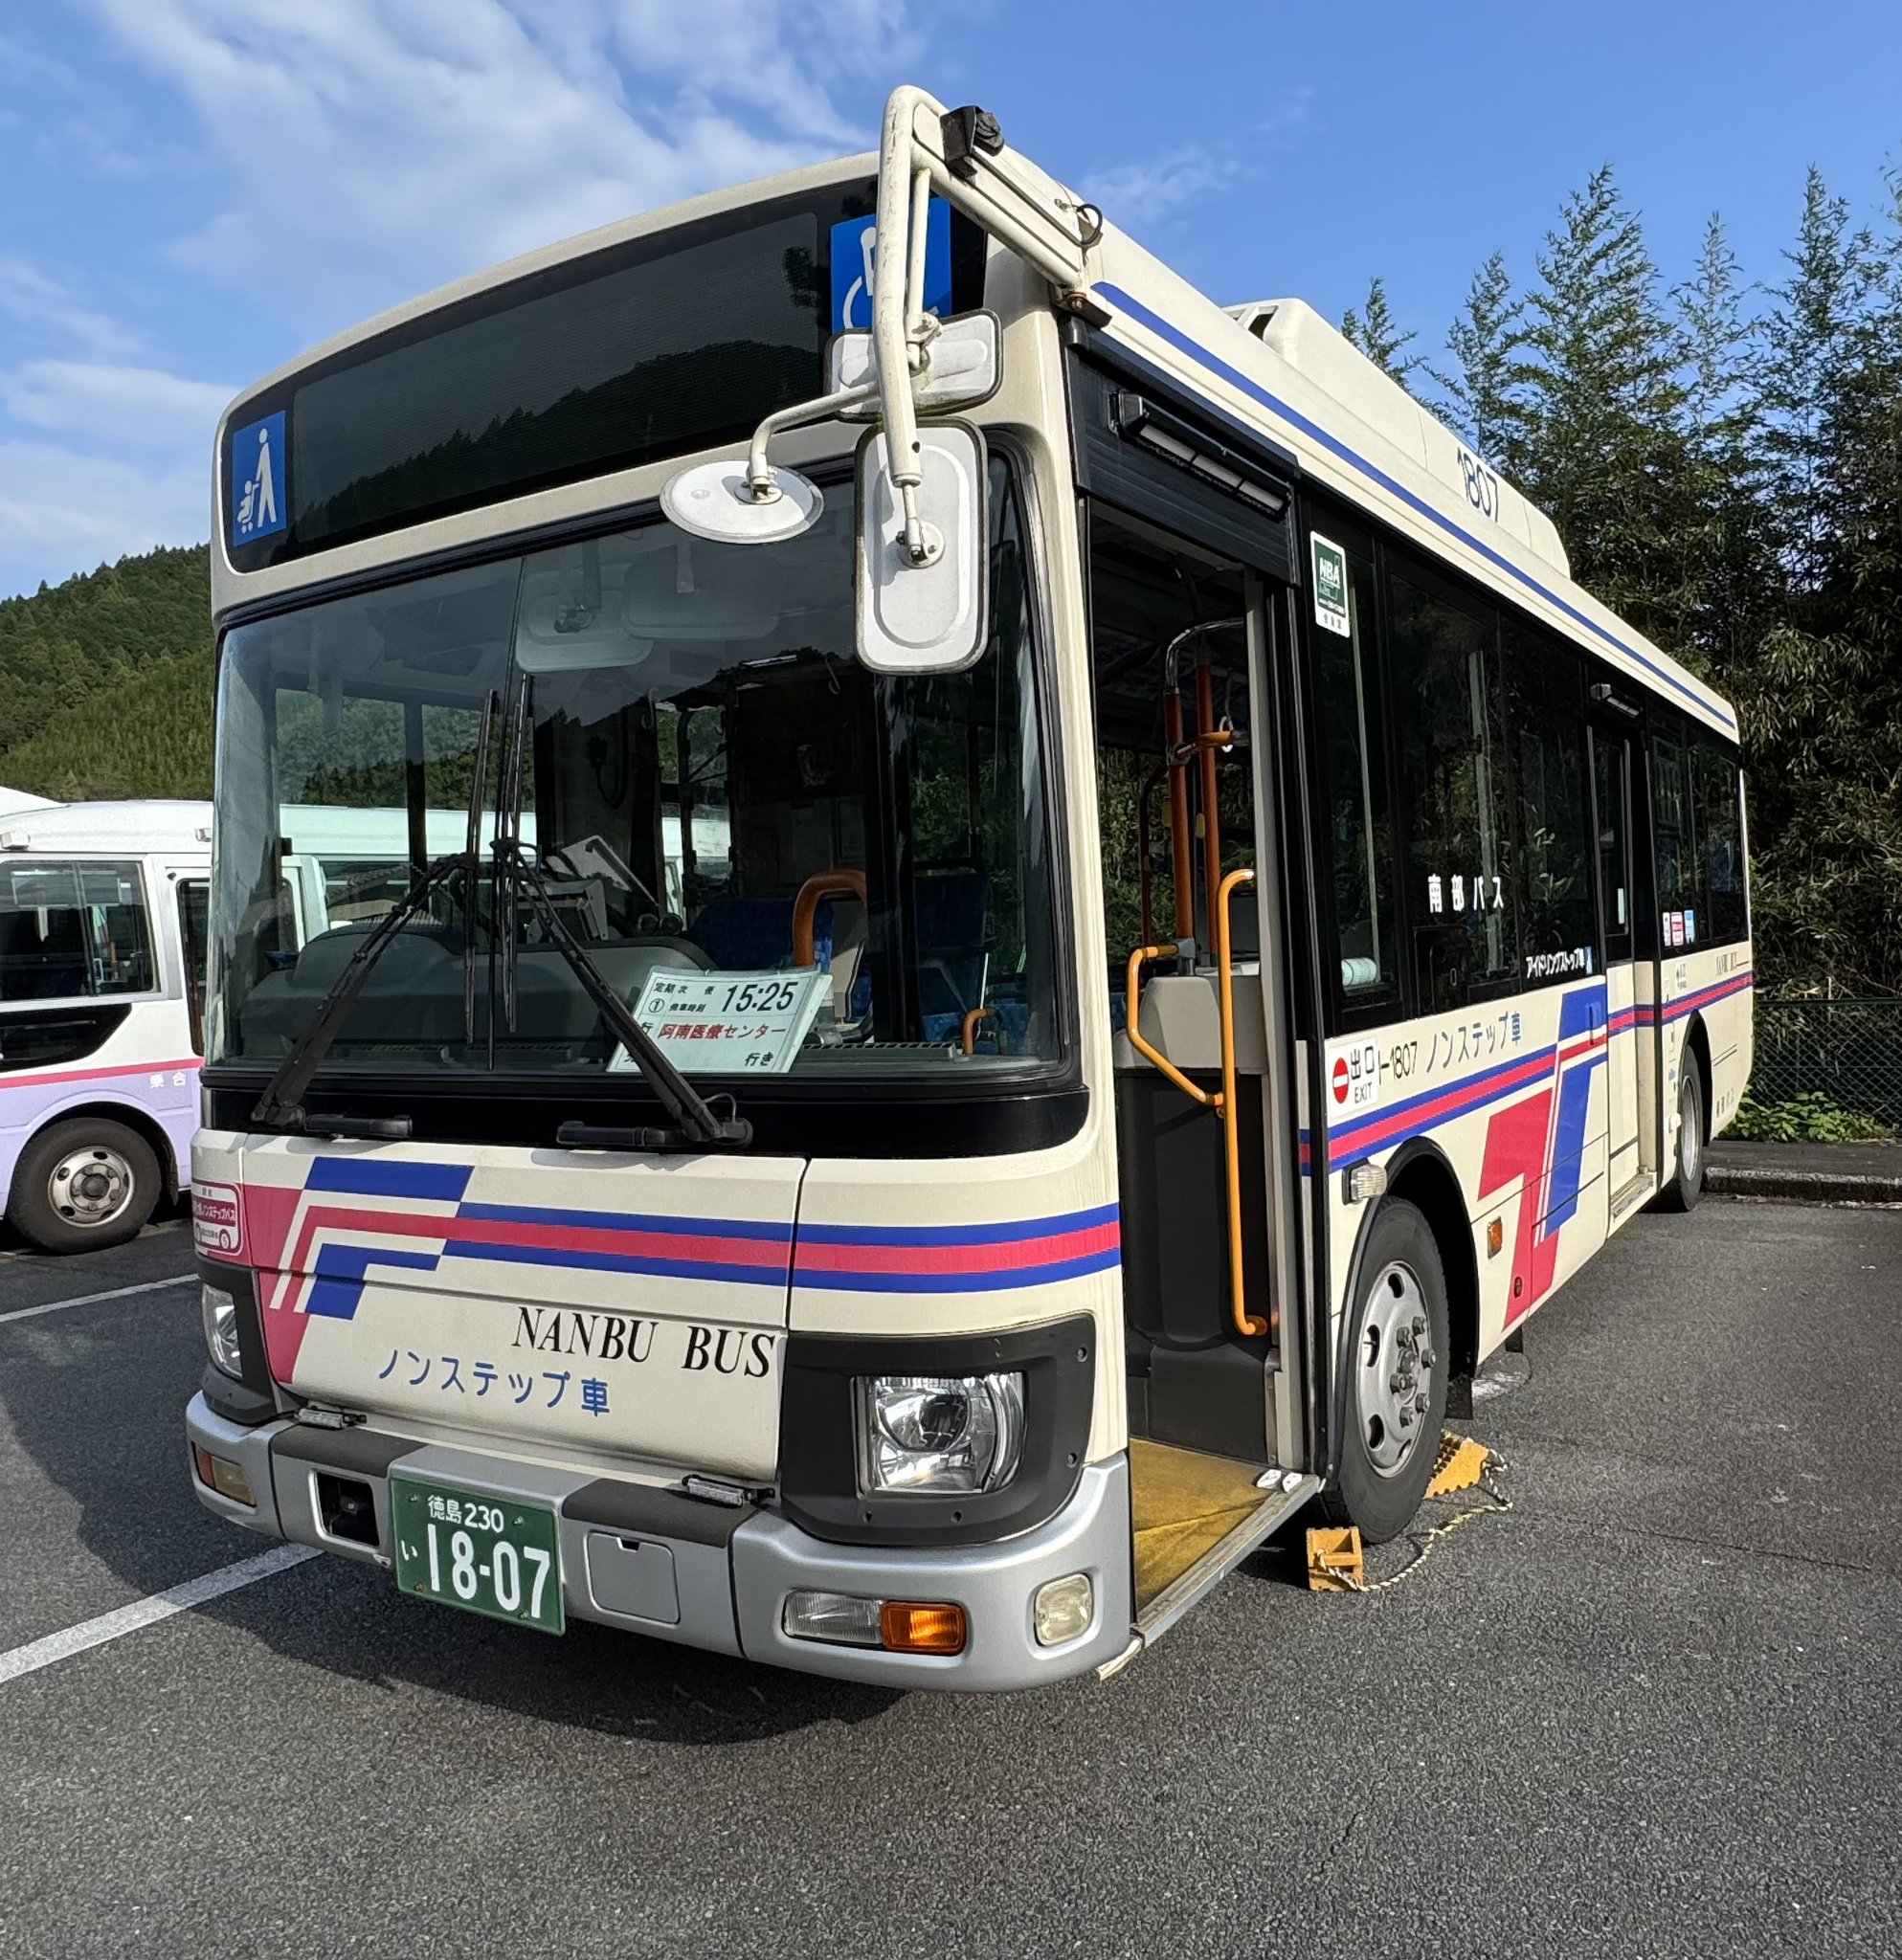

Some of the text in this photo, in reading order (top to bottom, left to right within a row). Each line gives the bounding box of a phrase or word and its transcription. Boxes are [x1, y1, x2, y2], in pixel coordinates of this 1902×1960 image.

[1457, 446, 1499, 523] 1807
[1427, 873, 1504, 913] 南部バス
[722, 982, 799, 1013] 15:25
[658, 1023, 787, 1040] 阿南医療センター
[1426, 1011, 1521, 1073] ノンステップ車
[745, 1052, 773, 1067] 行き
[1350, 1045, 1376, 1080] 出口
[1354, 1081, 1373, 1103] EXIT
[511, 1306, 776, 1378] NANBU BUS
[379, 1349, 611, 1416] ノンステップ車
[401, 1524, 550, 1618] い 18-07
